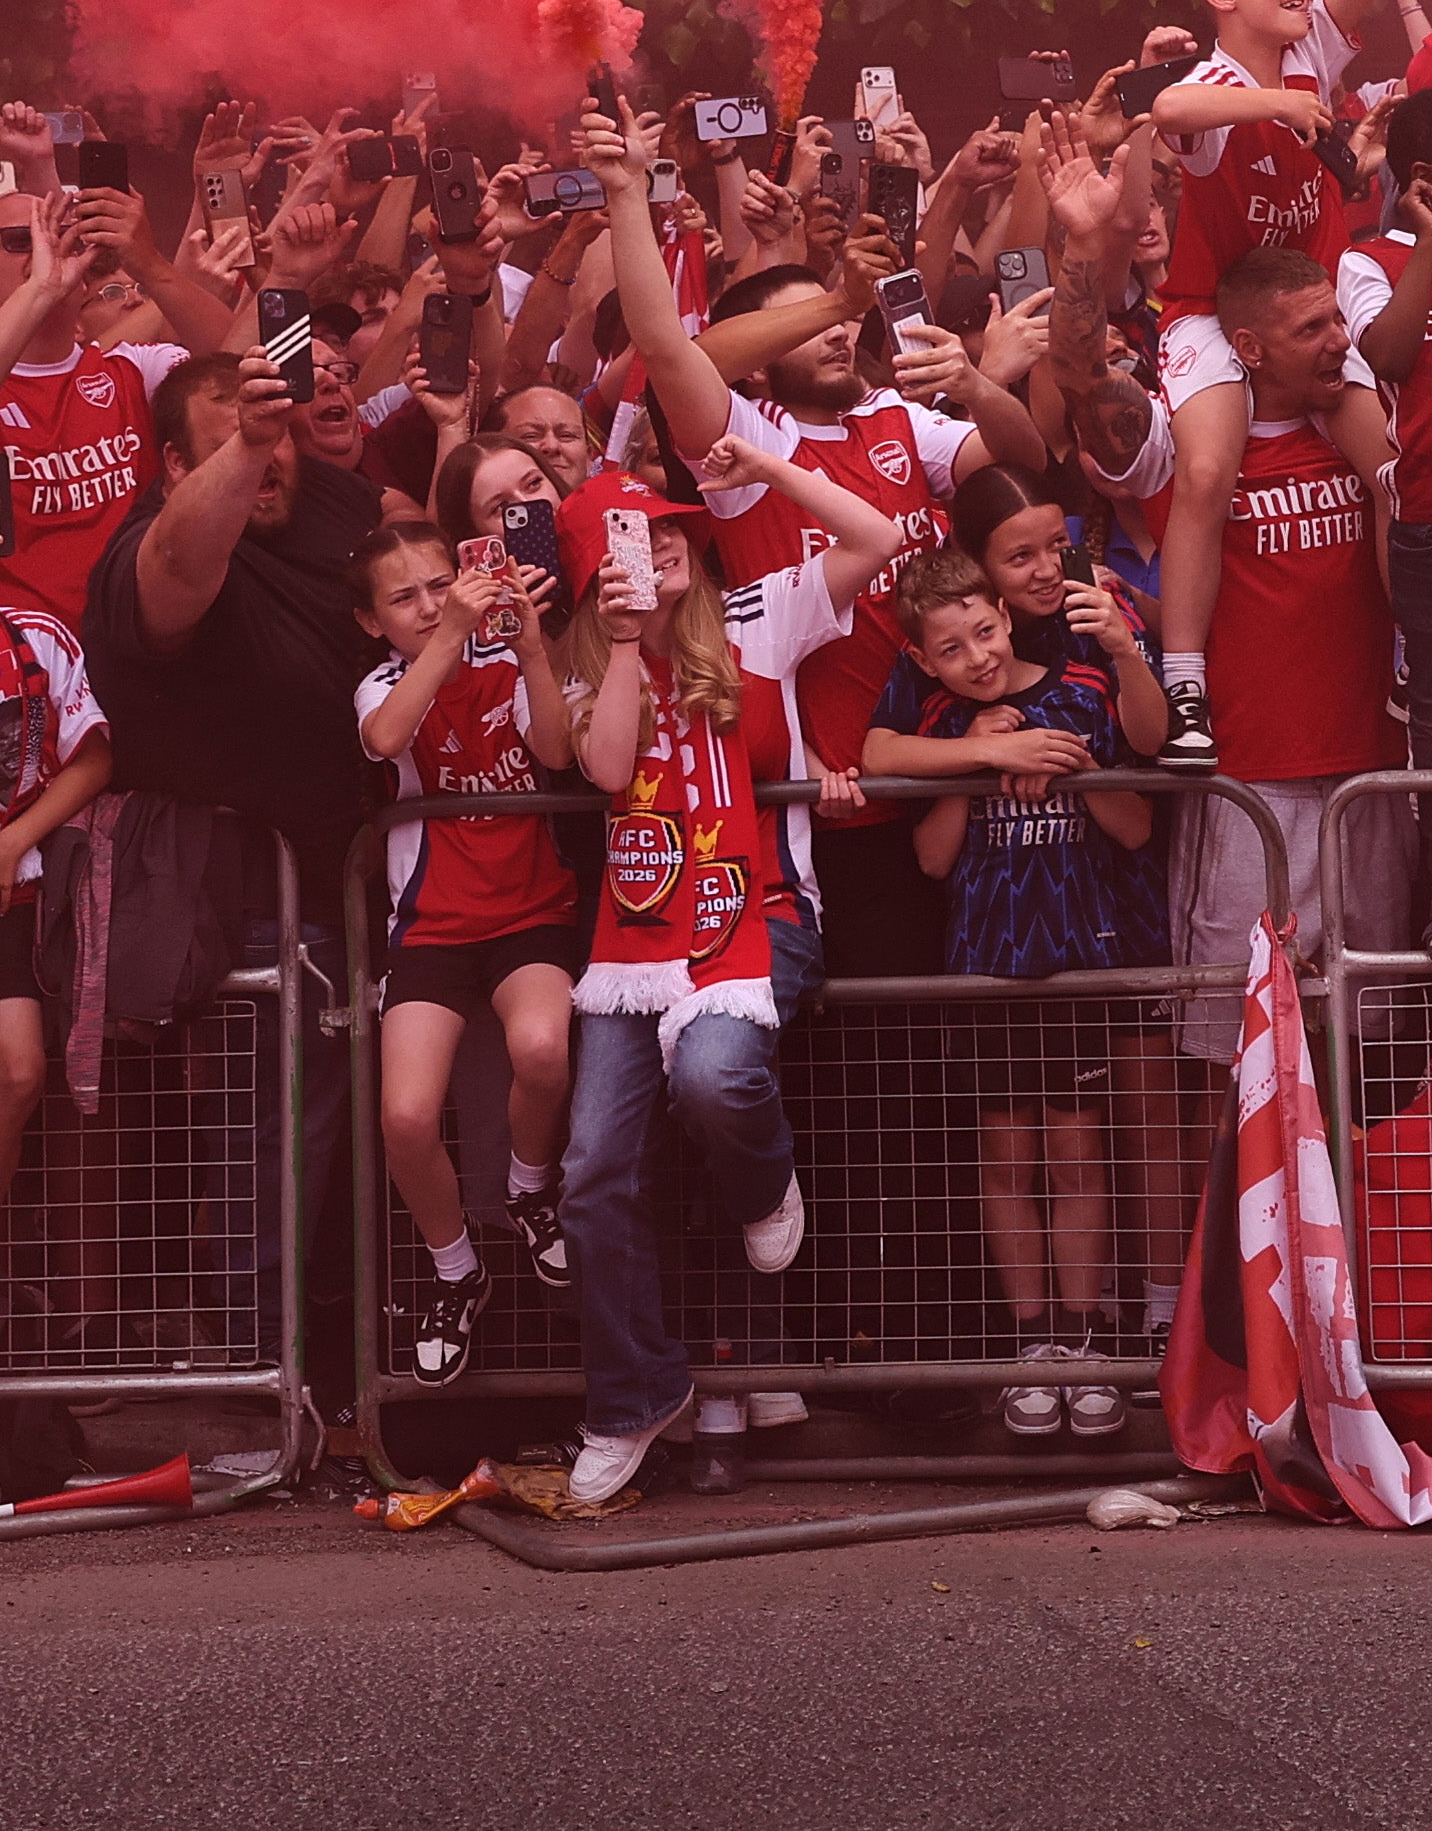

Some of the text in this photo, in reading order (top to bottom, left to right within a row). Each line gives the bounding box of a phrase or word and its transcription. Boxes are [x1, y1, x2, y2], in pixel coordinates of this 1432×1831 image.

[1260, 227, 1289, 247] FLY
[3, 425, 141, 481] Emirates
[32, 466, 137, 515] FLY BETTER
[1228, 473, 1365, 521] Emirate
[1257, 510, 1365, 556] FLY BETTER
[618, 828, 656, 848] AFC
[988, 818, 1087, 848] FLY BETTER
[607, 849, 684, 866] CHAMPIONS
[617, 869, 657, 883] 2026
[694, 876, 720, 896] FC
[695, 894, 746, 914] PIONS
[694, 915, 722, 933] 026
